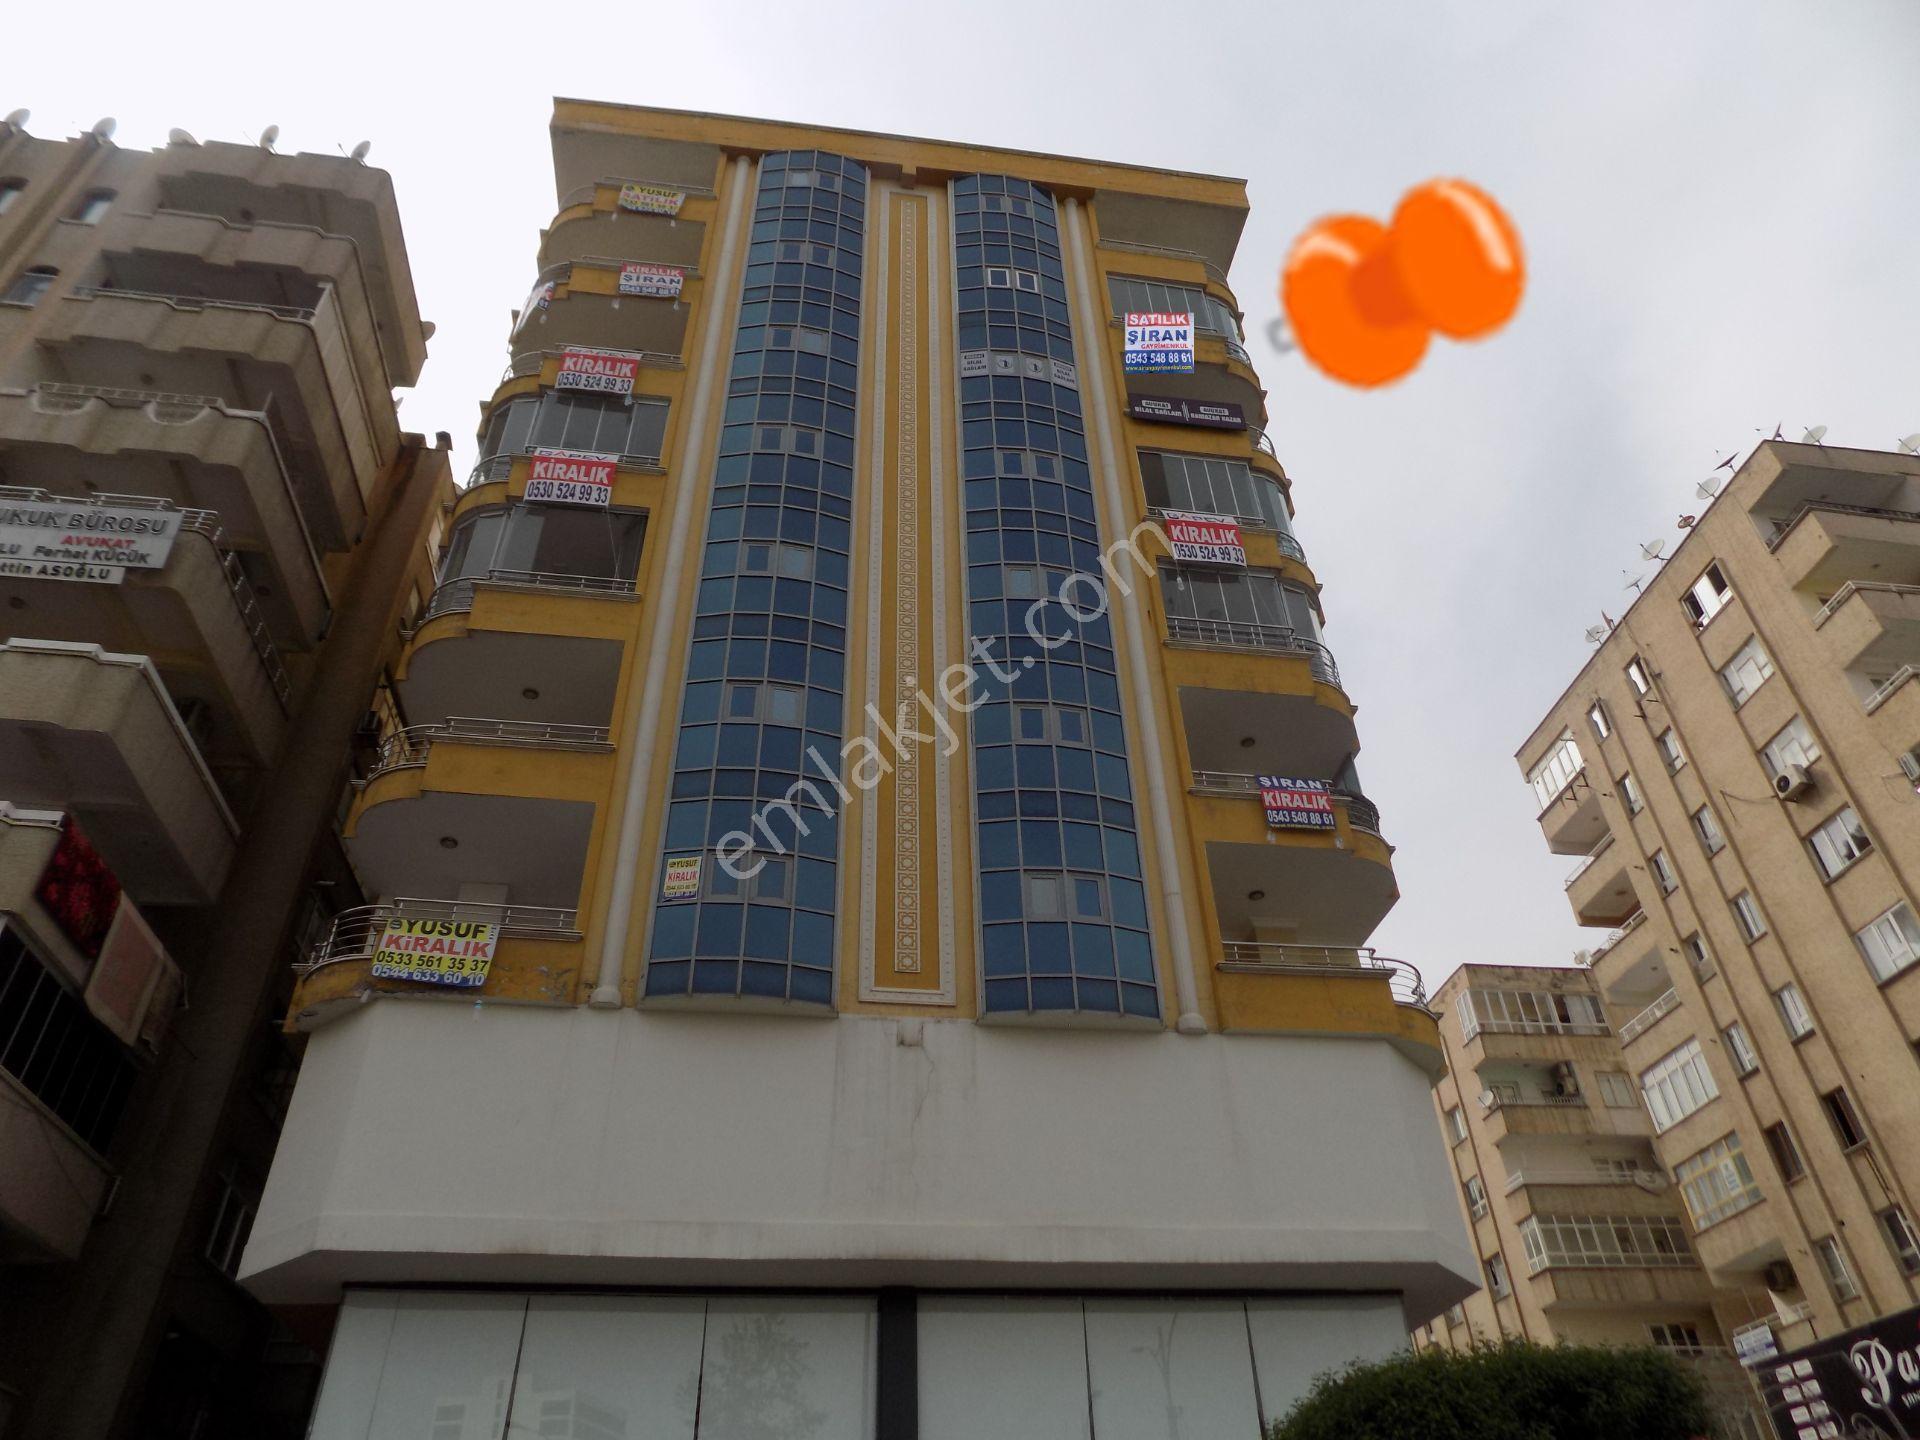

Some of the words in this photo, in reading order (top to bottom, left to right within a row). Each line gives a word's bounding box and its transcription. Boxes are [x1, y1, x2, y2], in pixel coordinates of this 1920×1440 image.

[1129, 314, 1188, 325] SATILIK
[1127, 327, 1188, 346] ŞİRAN
[563, 356, 634, 377] KİRALIK
[1125, 353, 1148, 364] 0543
[1150, 352, 1166, 363] 548
[1168, 352, 1180, 363] 88
[1181, 352, 1192, 363] 61
[557, 373, 582, 387] 0530
[583, 376, 602, 388] 524
[604, 377, 616, 391] 99
[618, 379, 631, 391] 33
[533, 459, 610, 484] KİRALIK
[527, 481, 554, 498] 0530
[556, 483, 576, 500] 524
[578, 485, 593, 501] 99
[594, 487, 609, 503] 33
[67, 510, 168, 535] BÜROSU
[60, 534, 136, 549] AVUKAT
[1170, 522, 1239, 545] KİRALIK
[1174, 543, 1198, 558] 0530
[1199, 545, 1217, 560] 524
[1219, 547, 1231, 561] 99
[1232, 547, 1245, 564] 33
[37, 562, 110, 580] ASOĞLU
[1262, 790, 1331, 810] KİRALIK
[1267, 810, 1289, 822] 0543
[1291, 811, 1309, 824] 548
[1309, 812, 1321, 825] 88
[1323, 813, 1334, 825] 61
[676, 859, 698, 868] YUSUF
[407, 919, 487, 939] YUSUF
[376, 951, 413, 966] 0533
[415, 954, 443, 968] 561
[447, 957, 466, 971] 35
[469, 959, 489, 973] 37
[372, 964, 409, 979] 0544
[412, 968, 440, 982] 633
[443, 971, 463, 984] 60
[467, 973, 485, 985] 10
